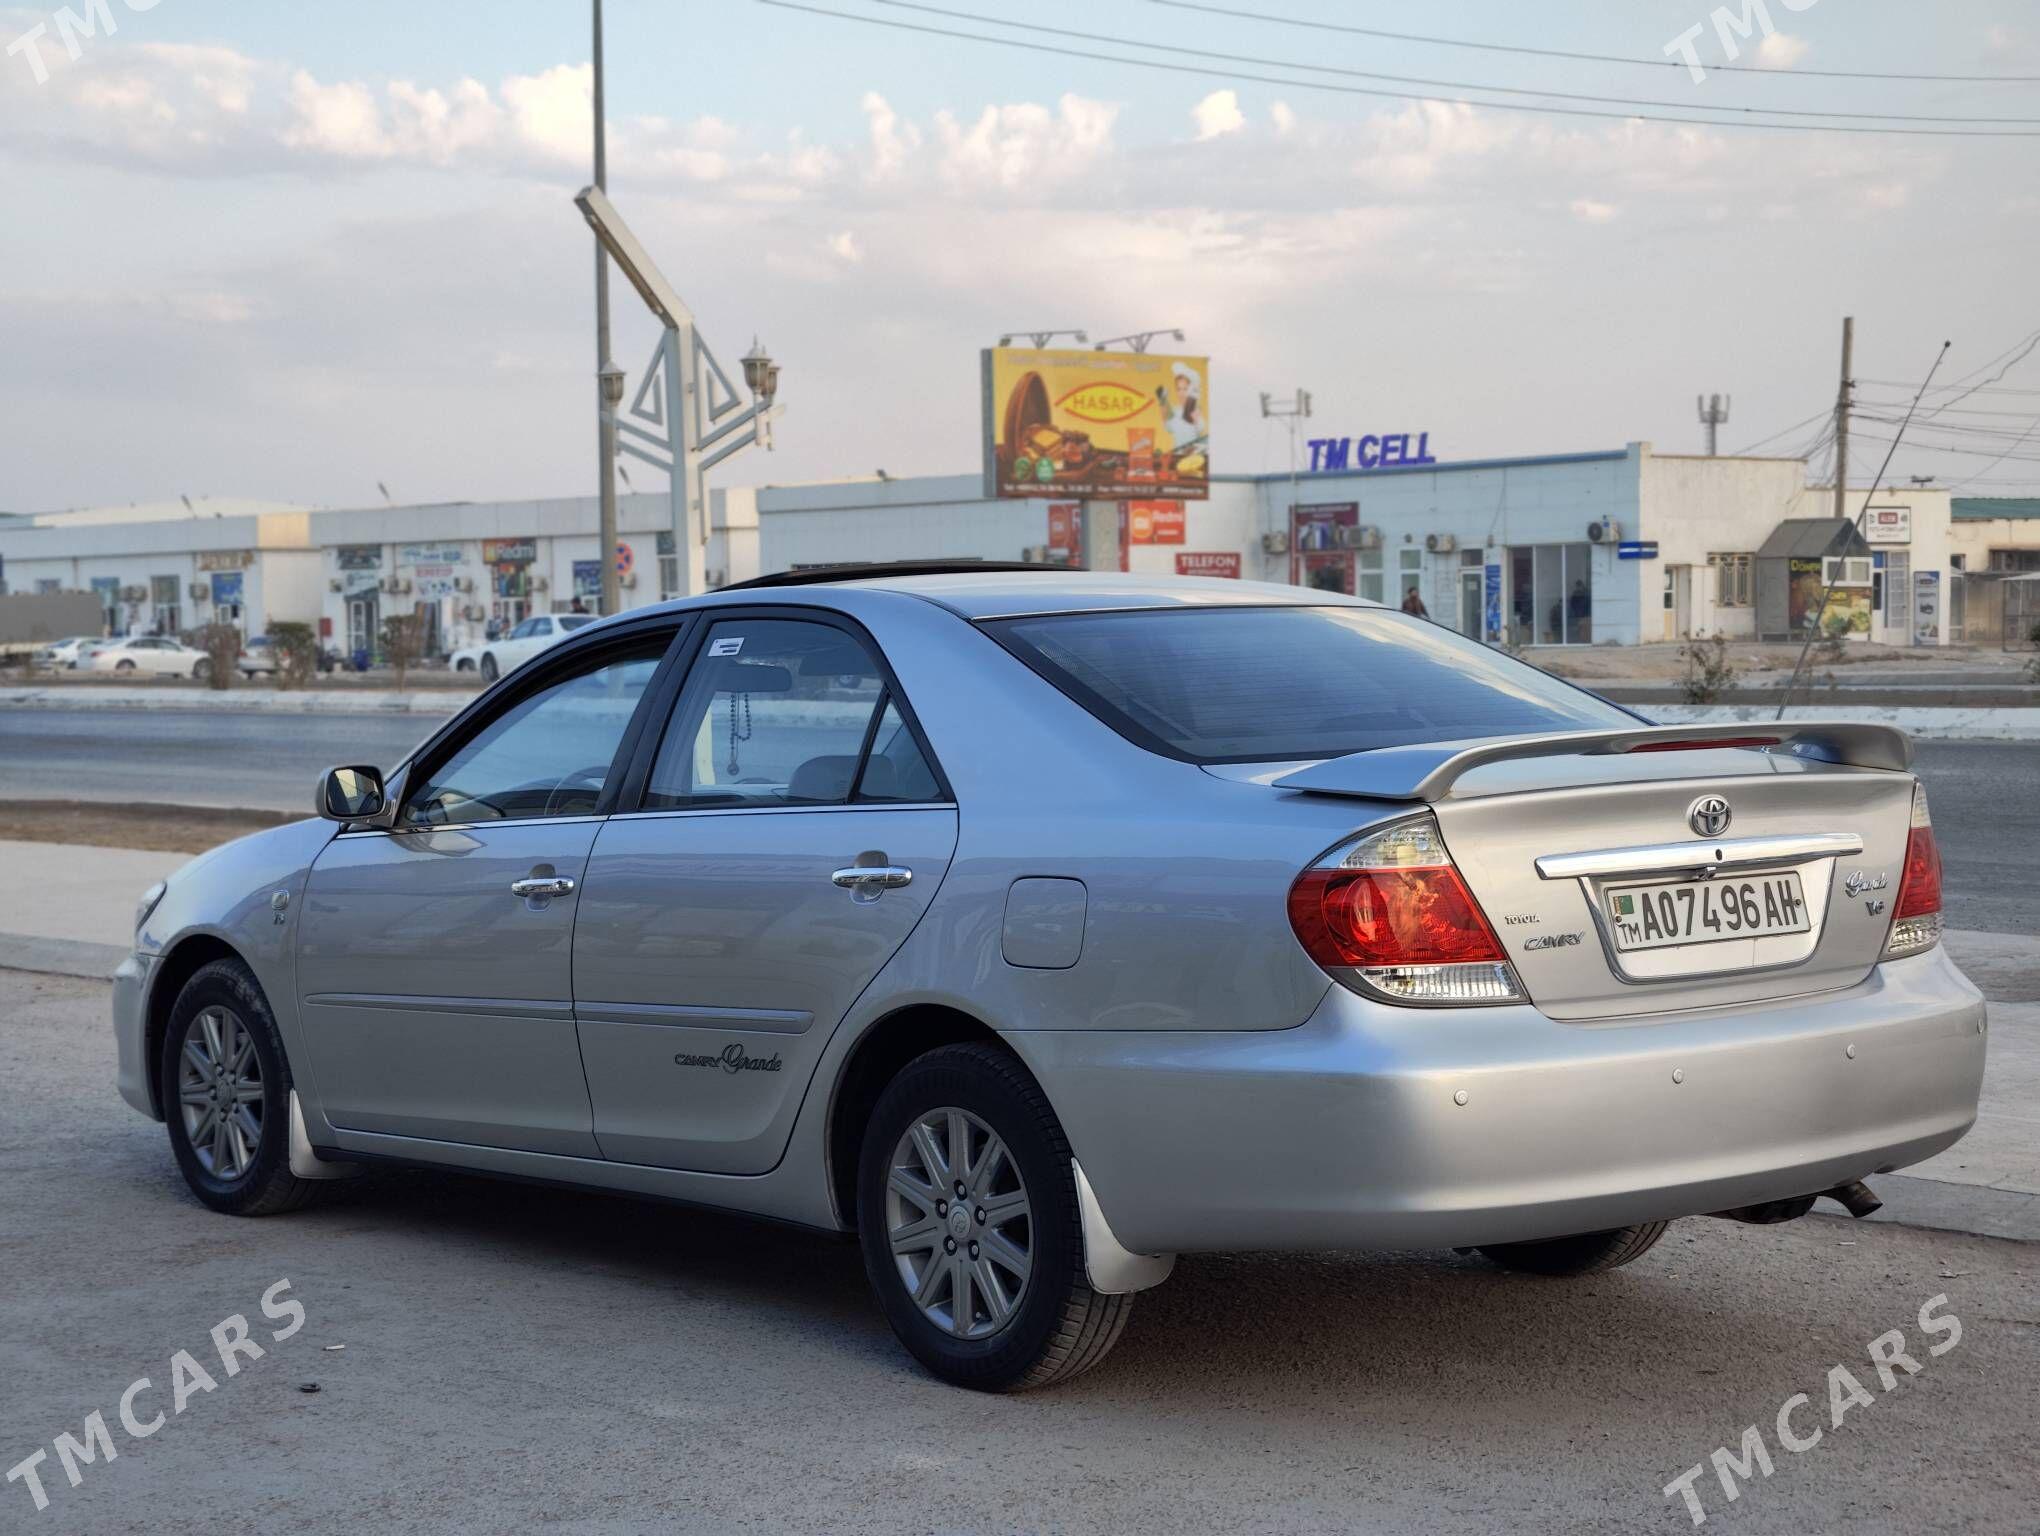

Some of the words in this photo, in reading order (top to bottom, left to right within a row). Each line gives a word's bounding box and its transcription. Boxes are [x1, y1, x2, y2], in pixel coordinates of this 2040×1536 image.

[1072, 394, 1136, 412] HASAR
[1307, 438, 1351, 472] TM
[1357, 432, 1437, 468] CELL
[1180, 556, 1237, 568] TELEFON
[1619, 922, 1643, 945] TM
[1641, 879, 1799, 940] A07496AH
[1524, 929, 1585, 951] CAMRY
[674, 1053, 721, 1068] CAMRY
[721, 1043, 783, 1074] Grande
